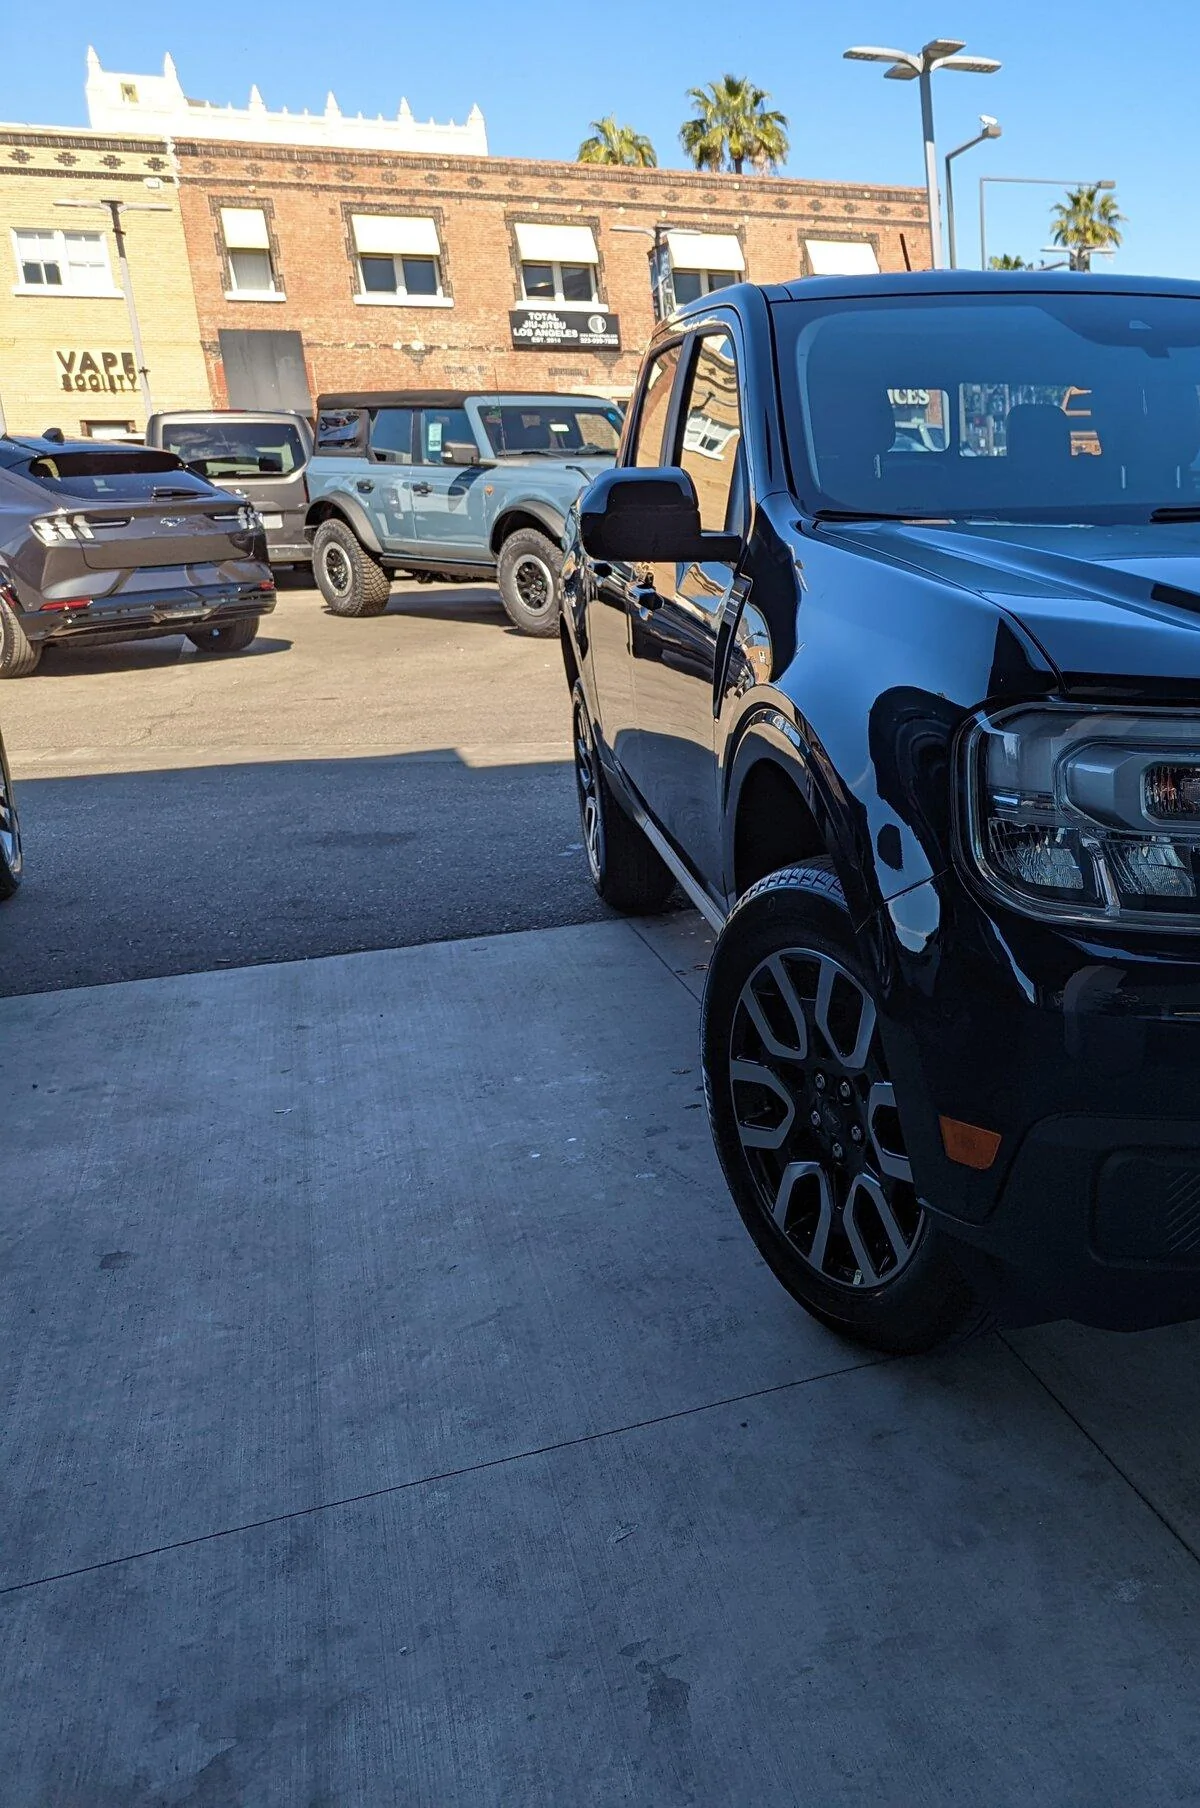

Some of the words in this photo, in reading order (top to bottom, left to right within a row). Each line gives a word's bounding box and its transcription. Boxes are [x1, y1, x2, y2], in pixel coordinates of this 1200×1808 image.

[528, 312, 559, 321] TOTAL
[522, 320, 566, 329] JIU-JITSU
[513, 328, 533, 336] LOS
[534, 329, 578, 338] ANGELES
[56, 351, 135, 374] VAPE
